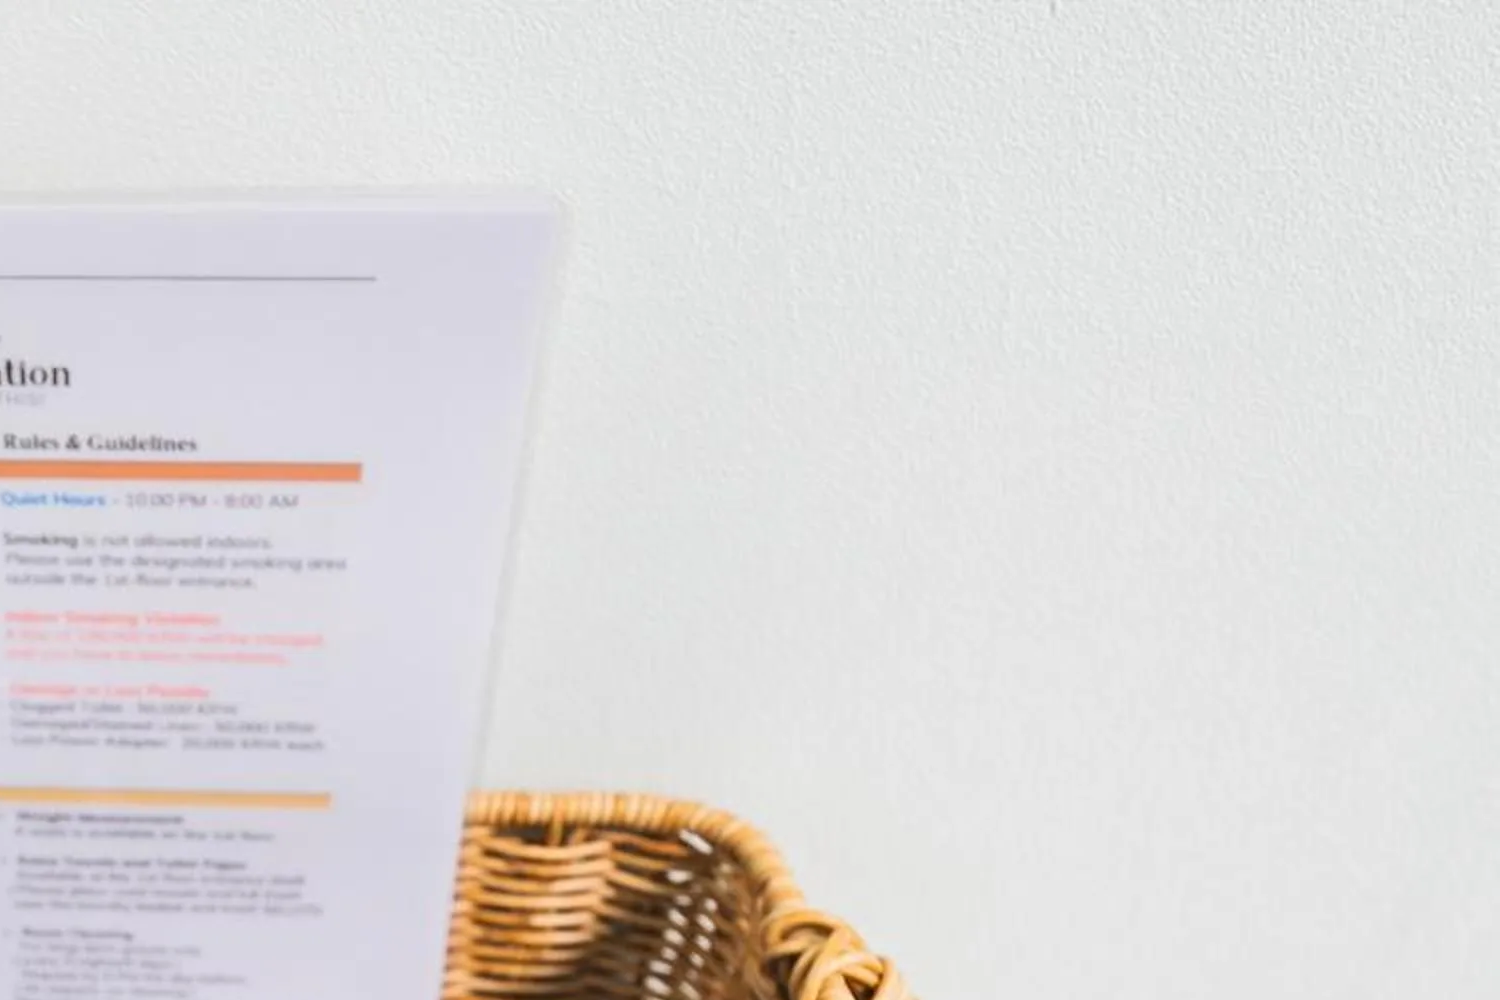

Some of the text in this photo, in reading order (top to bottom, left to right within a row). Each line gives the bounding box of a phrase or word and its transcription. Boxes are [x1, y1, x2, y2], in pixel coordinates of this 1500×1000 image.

[2, 434, 59, 451] Rules
[65, 435, 80, 451] &
[86, 435, 198, 453] Guidelines
[1, 492, 47, 508] Quiet
[53, 493, 105, 509] Hours
[3, 533, 78, 549] Smoking
